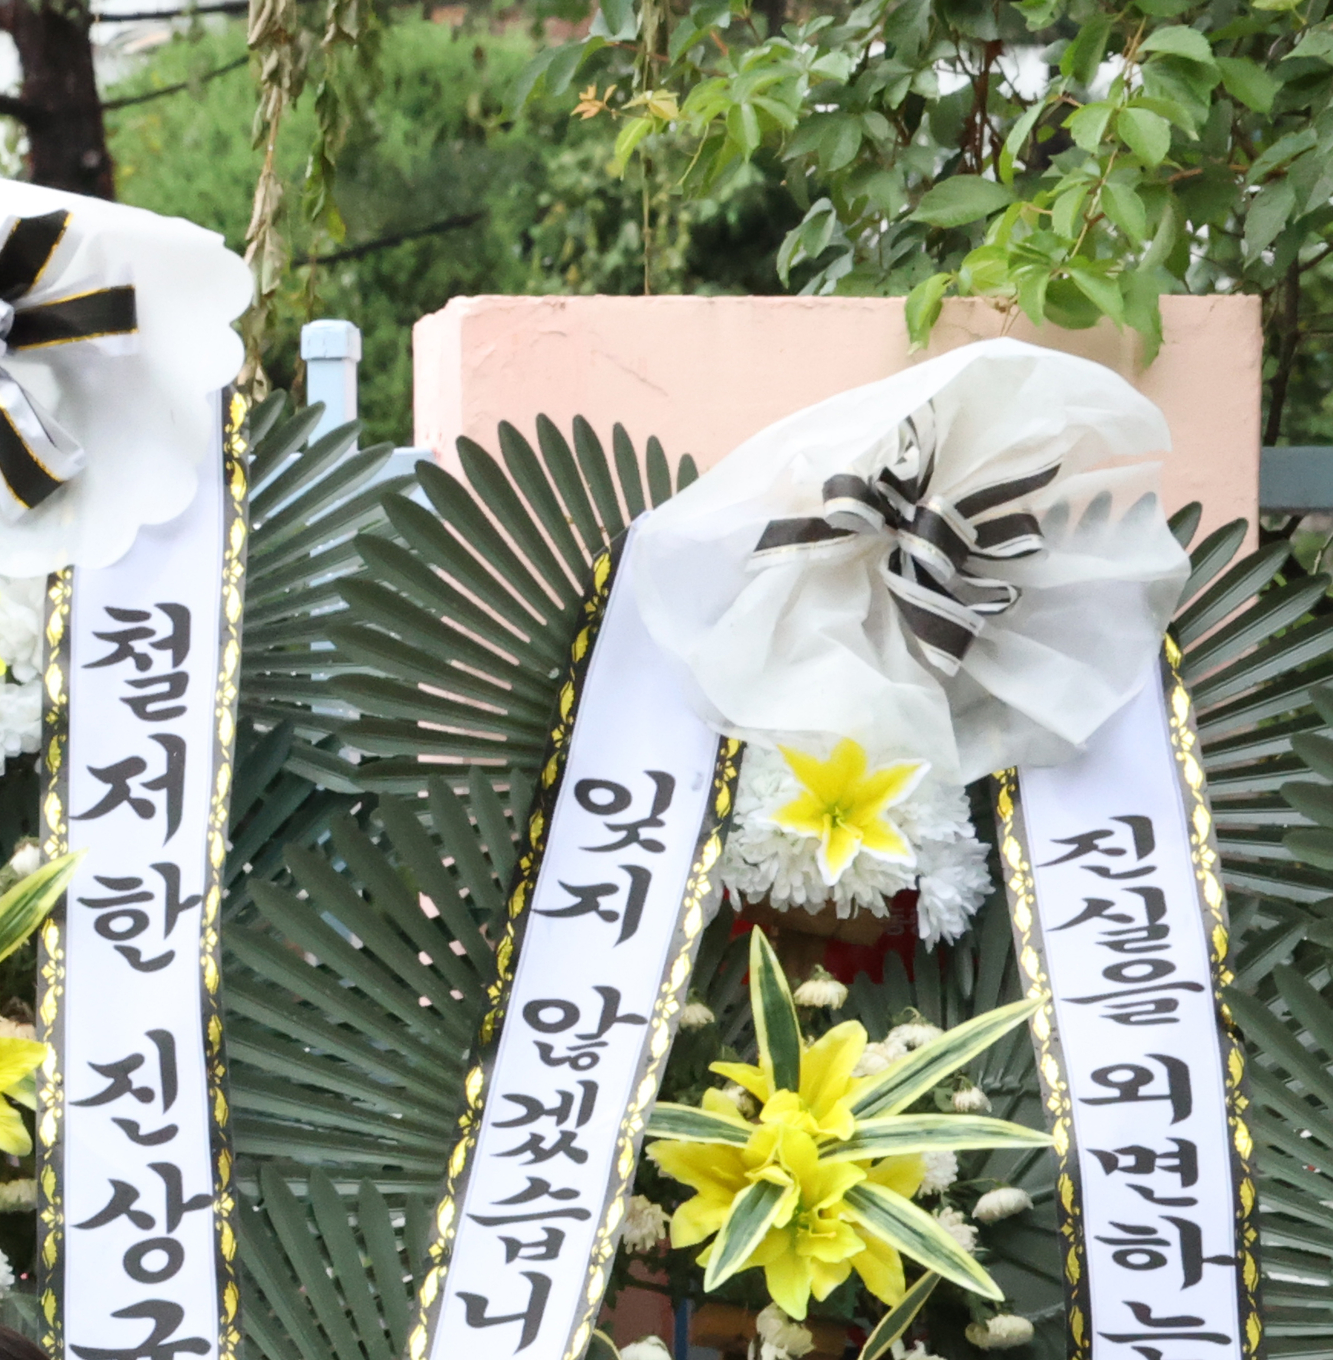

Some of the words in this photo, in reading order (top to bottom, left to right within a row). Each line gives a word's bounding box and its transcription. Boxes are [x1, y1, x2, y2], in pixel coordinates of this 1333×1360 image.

[68, 602, 202, 973] 철저한
[532, 770, 676, 947] 잊지
[1037, 814, 1204, 1025] 진실을
